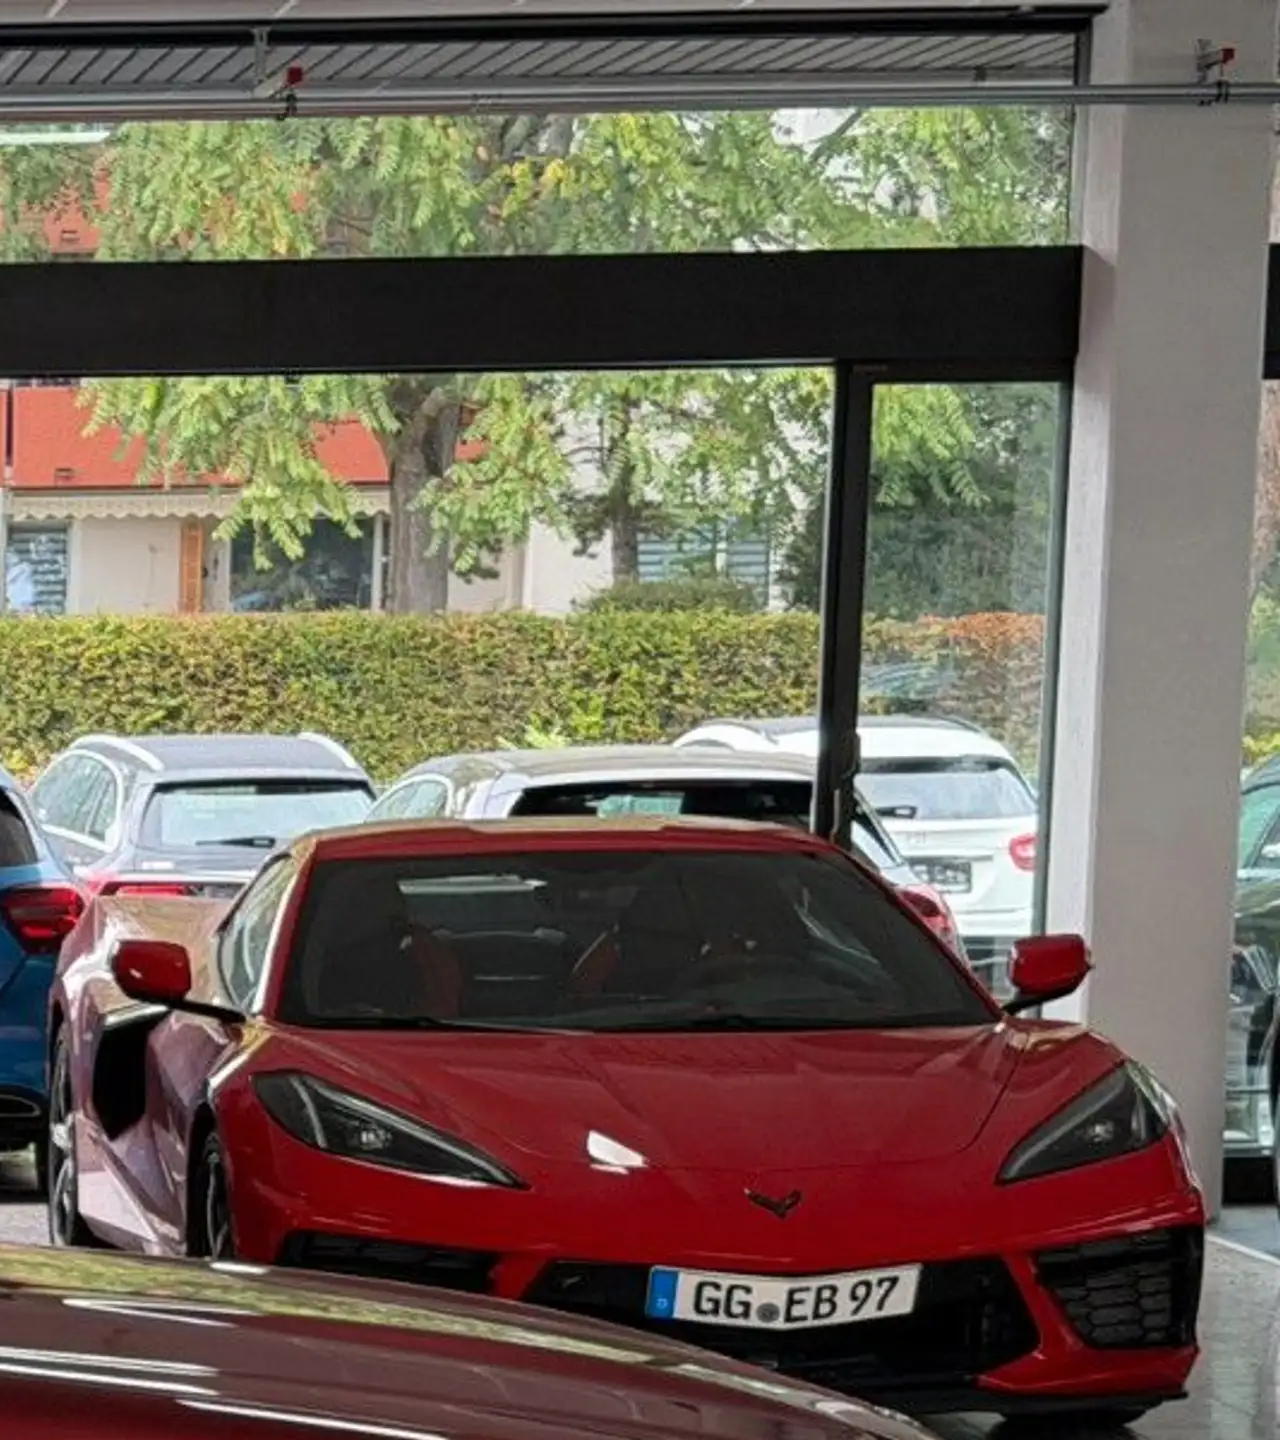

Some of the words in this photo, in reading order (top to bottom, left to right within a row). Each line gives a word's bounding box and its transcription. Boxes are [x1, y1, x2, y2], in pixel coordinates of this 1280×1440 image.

[693, 1280, 752, 1319] GG
[784, 1284, 839, 1323] EB
[849, 1275, 900, 1317] 97
